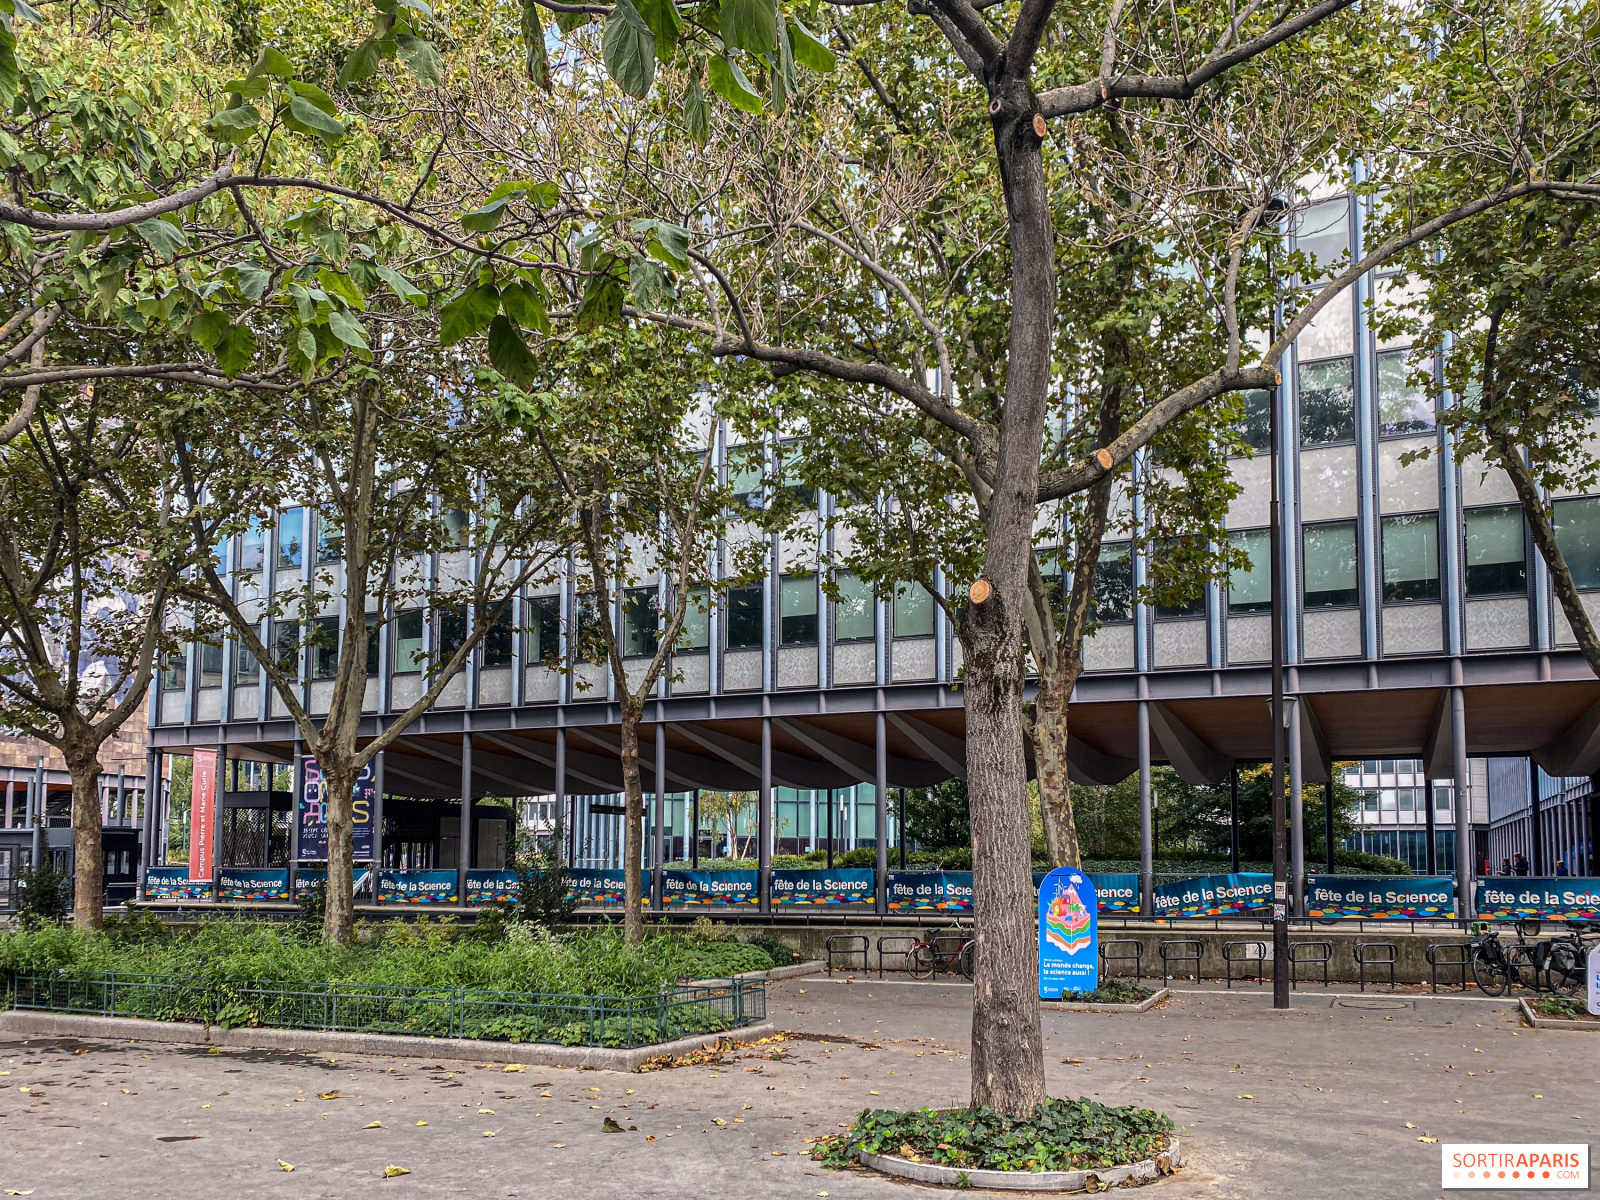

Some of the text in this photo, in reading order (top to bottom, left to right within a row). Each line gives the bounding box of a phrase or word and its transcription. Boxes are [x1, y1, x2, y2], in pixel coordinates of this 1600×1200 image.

[200, 814, 206, 823] et
[198, 847, 206, 878] Campus
[161, 876, 169, 885] de
[170, 877, 176, 885] la
[234, 878, 242, 888] de
[243, 879, 250, 888] la
[250, 879, 283, 888] Science
[396, 880, 407, 891] de
[409, 881, 417, 891] la
[418, 880, 451, 891] Science
[483, 879, 494, 889] de
[496, 880, 504, 889] la
[579, 877, 592, 888] de
[593, 878, 602, 888] la
[603, 878, 626, 889] Scie
[666, 879, 752, 891] fête de la Science
[774, 879, 868, 890] fête de la Science
[893, 884, 973, 895] fête de la Scie
[1095, 886, 1133, 898] ience
[1155, 884, 1272, 908] fête de la Science
[1314, 888, 1448, 904] fête de la Science
[1484, 890, 1600, 905] fête de la Scie
